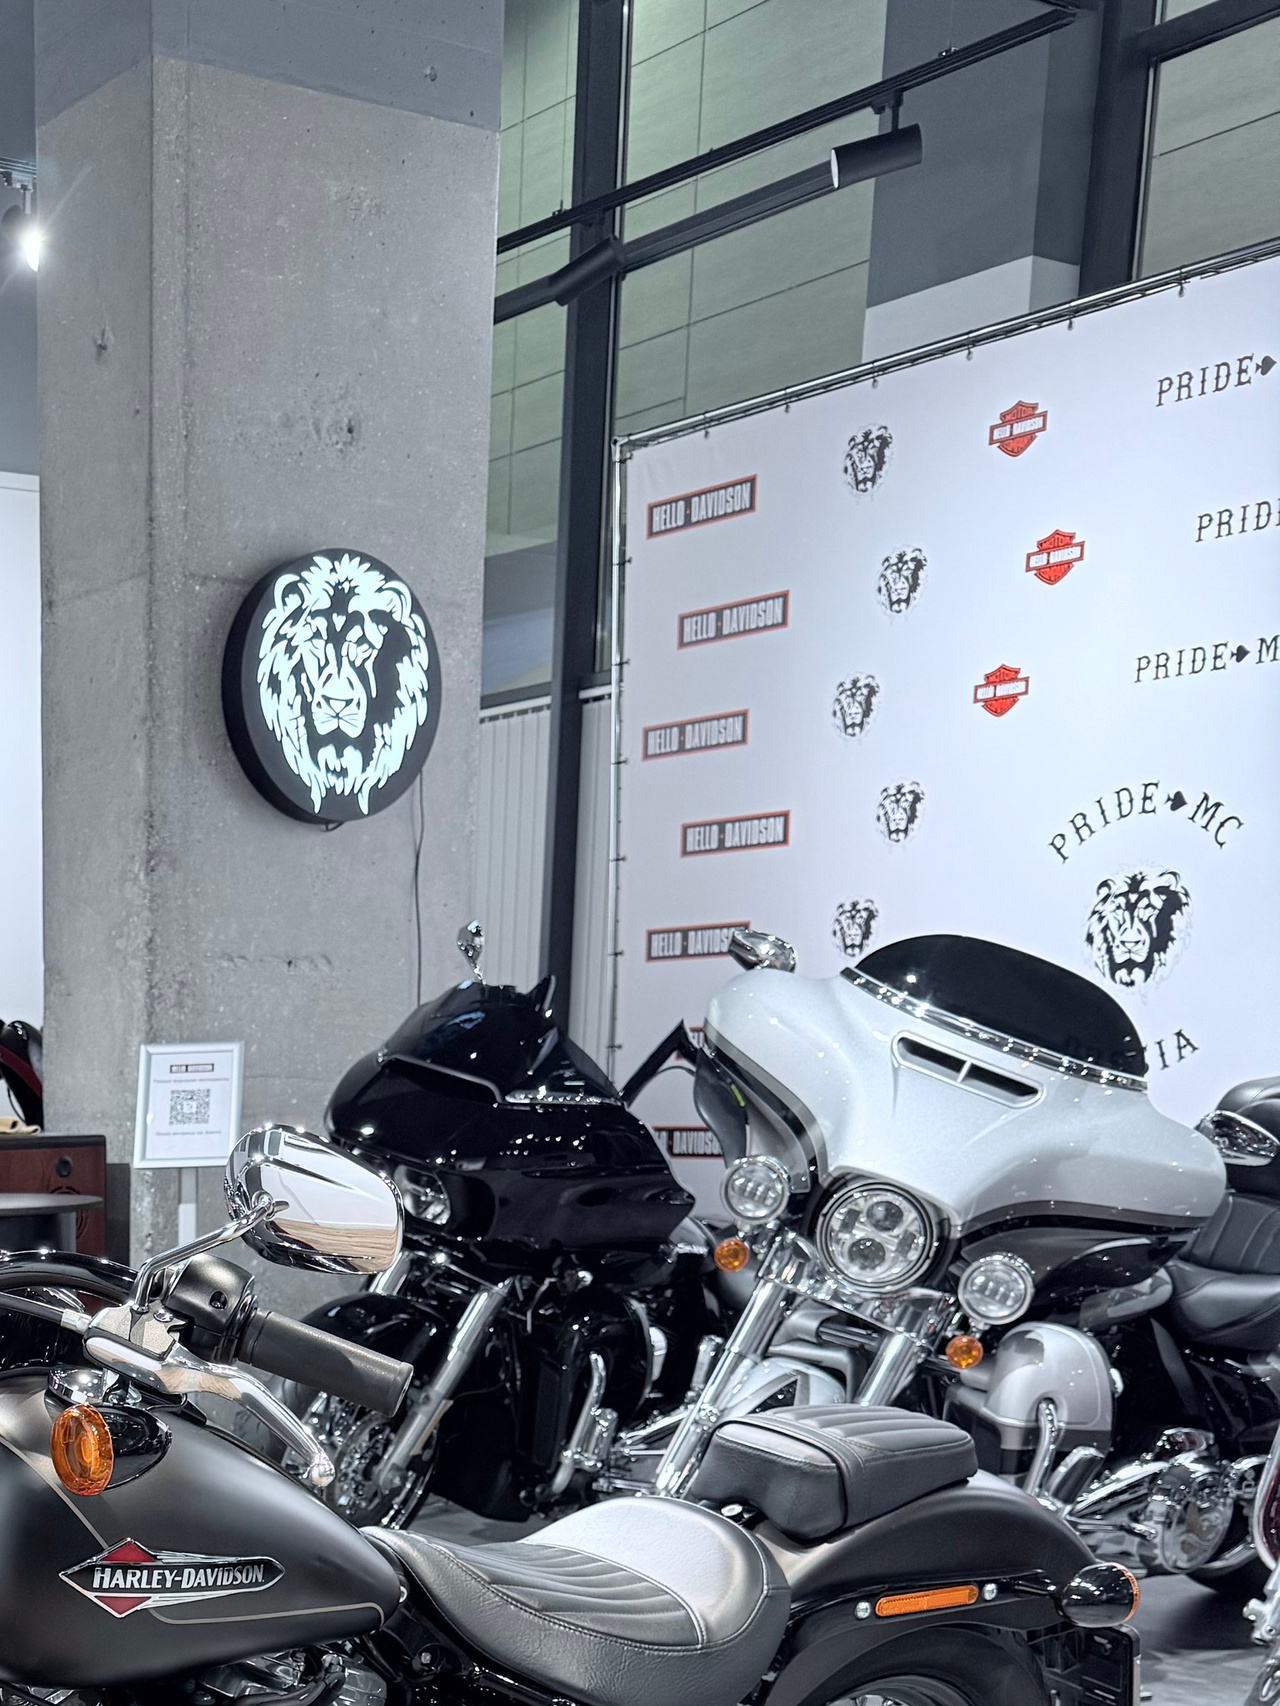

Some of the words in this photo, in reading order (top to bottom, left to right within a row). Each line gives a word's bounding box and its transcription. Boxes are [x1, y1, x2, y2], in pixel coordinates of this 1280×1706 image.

[1155, 353, 1254, 407] PRIDE
[652, 500, 686, 534] HELLO
[691, 481, 752, 524] DAVIDSON
[1195, 498, 1280, 543] PRID
[683, 611, 717, 644] HELLO
[722, 597, 784, 636] DAVIDSON
[1134, 641, 1229, 683] PRIDE
[647, 726, 680, 756] HELLO
[684, 715, 744, 750] DAVIDSON
[686, 824, 719, 853] HELLO
[724, 815, 785, 848] DAVIDSON
[1047, 780, 1160, 864] PRIDE
[1187, 791, 1245, 850] MC
[650, 931, 683, 958] HELLO
[687, 926, 745, 955] DAVIDS
[672, 1130, 723, 1155] DAVIDSO
[92, 1564, 263, 1589] HARLEY-DAVIDSON
